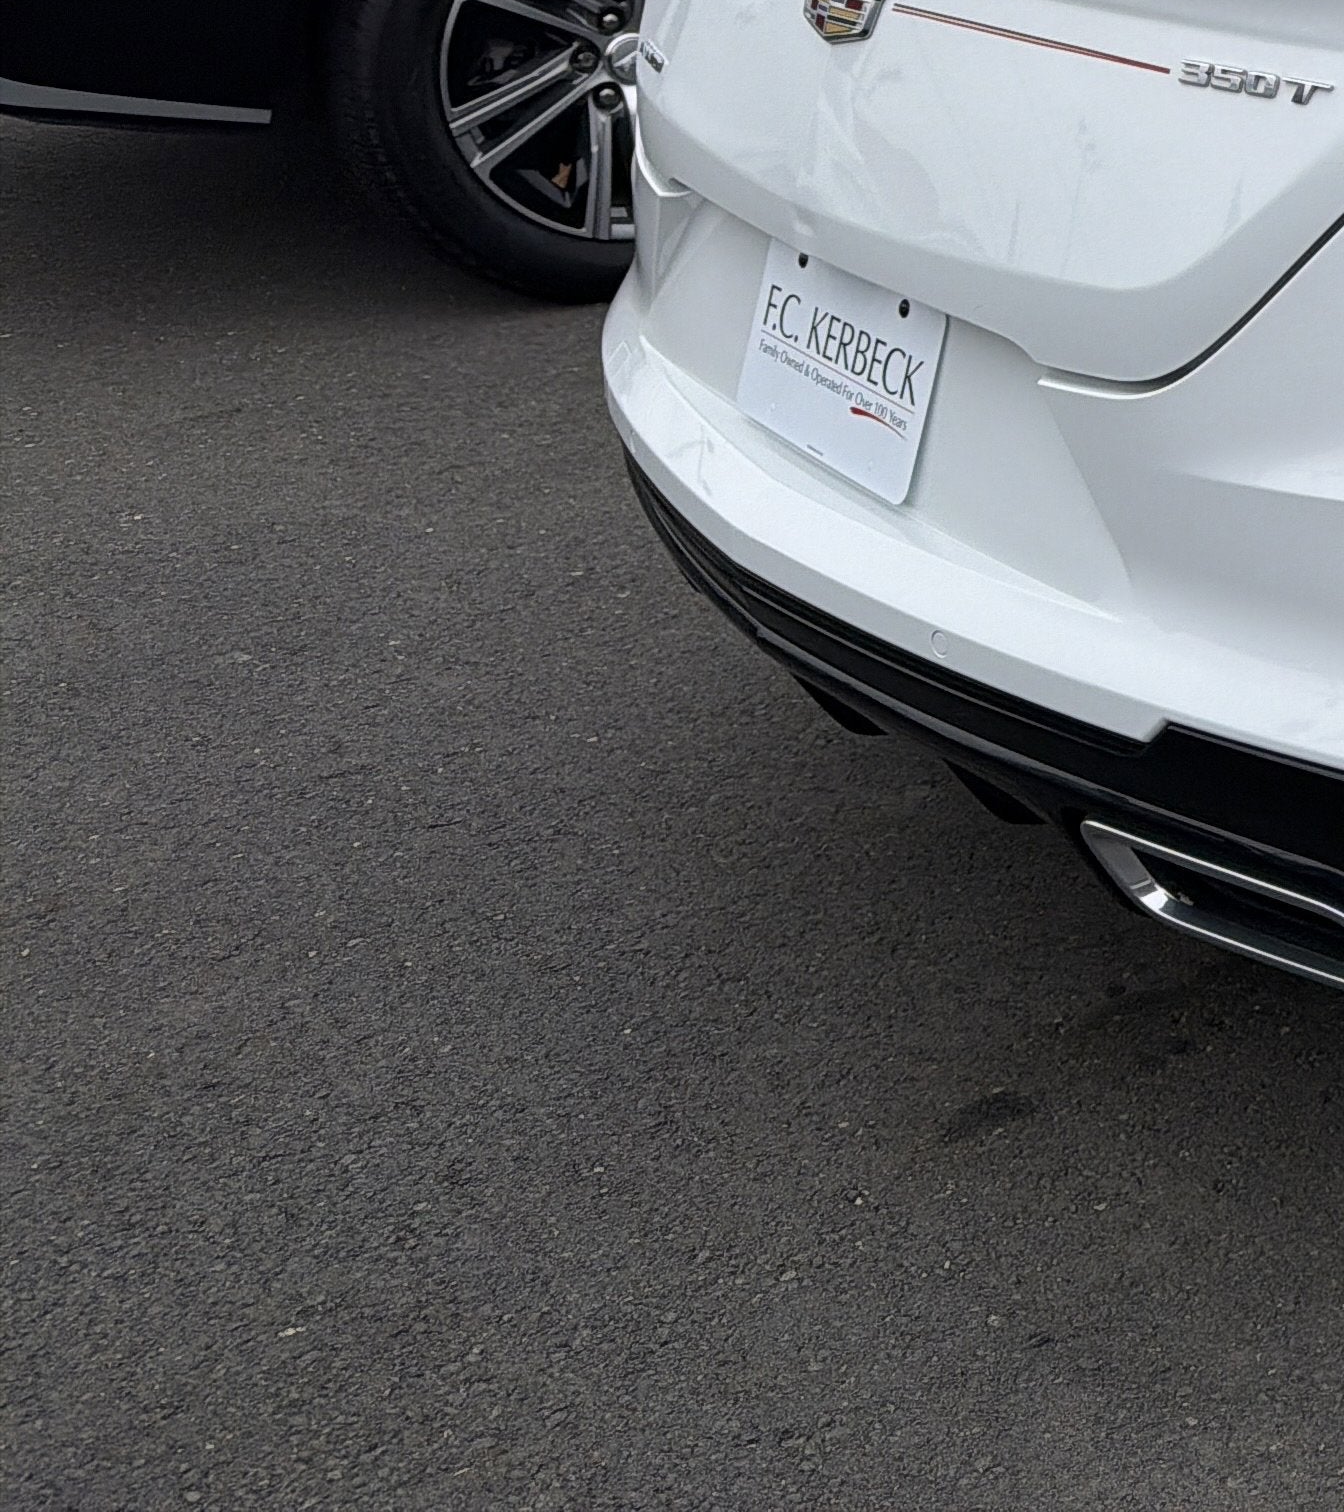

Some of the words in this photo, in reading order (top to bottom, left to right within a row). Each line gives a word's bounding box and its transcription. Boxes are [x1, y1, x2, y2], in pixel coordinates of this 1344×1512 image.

[1178, 59, 1335, 106] 350T
[760, 339, 779, 362] Family
[780, 350, 805, 373] Owned
[811, 367, 843, 395] Operated
[842, 384, 854, 401] For
[855, 392, 873, 411] Over
[889, 409, 907, 431] Years
[763, 284, 801, 342] F.C.
[806, 307, 924, 406] KERBECK
